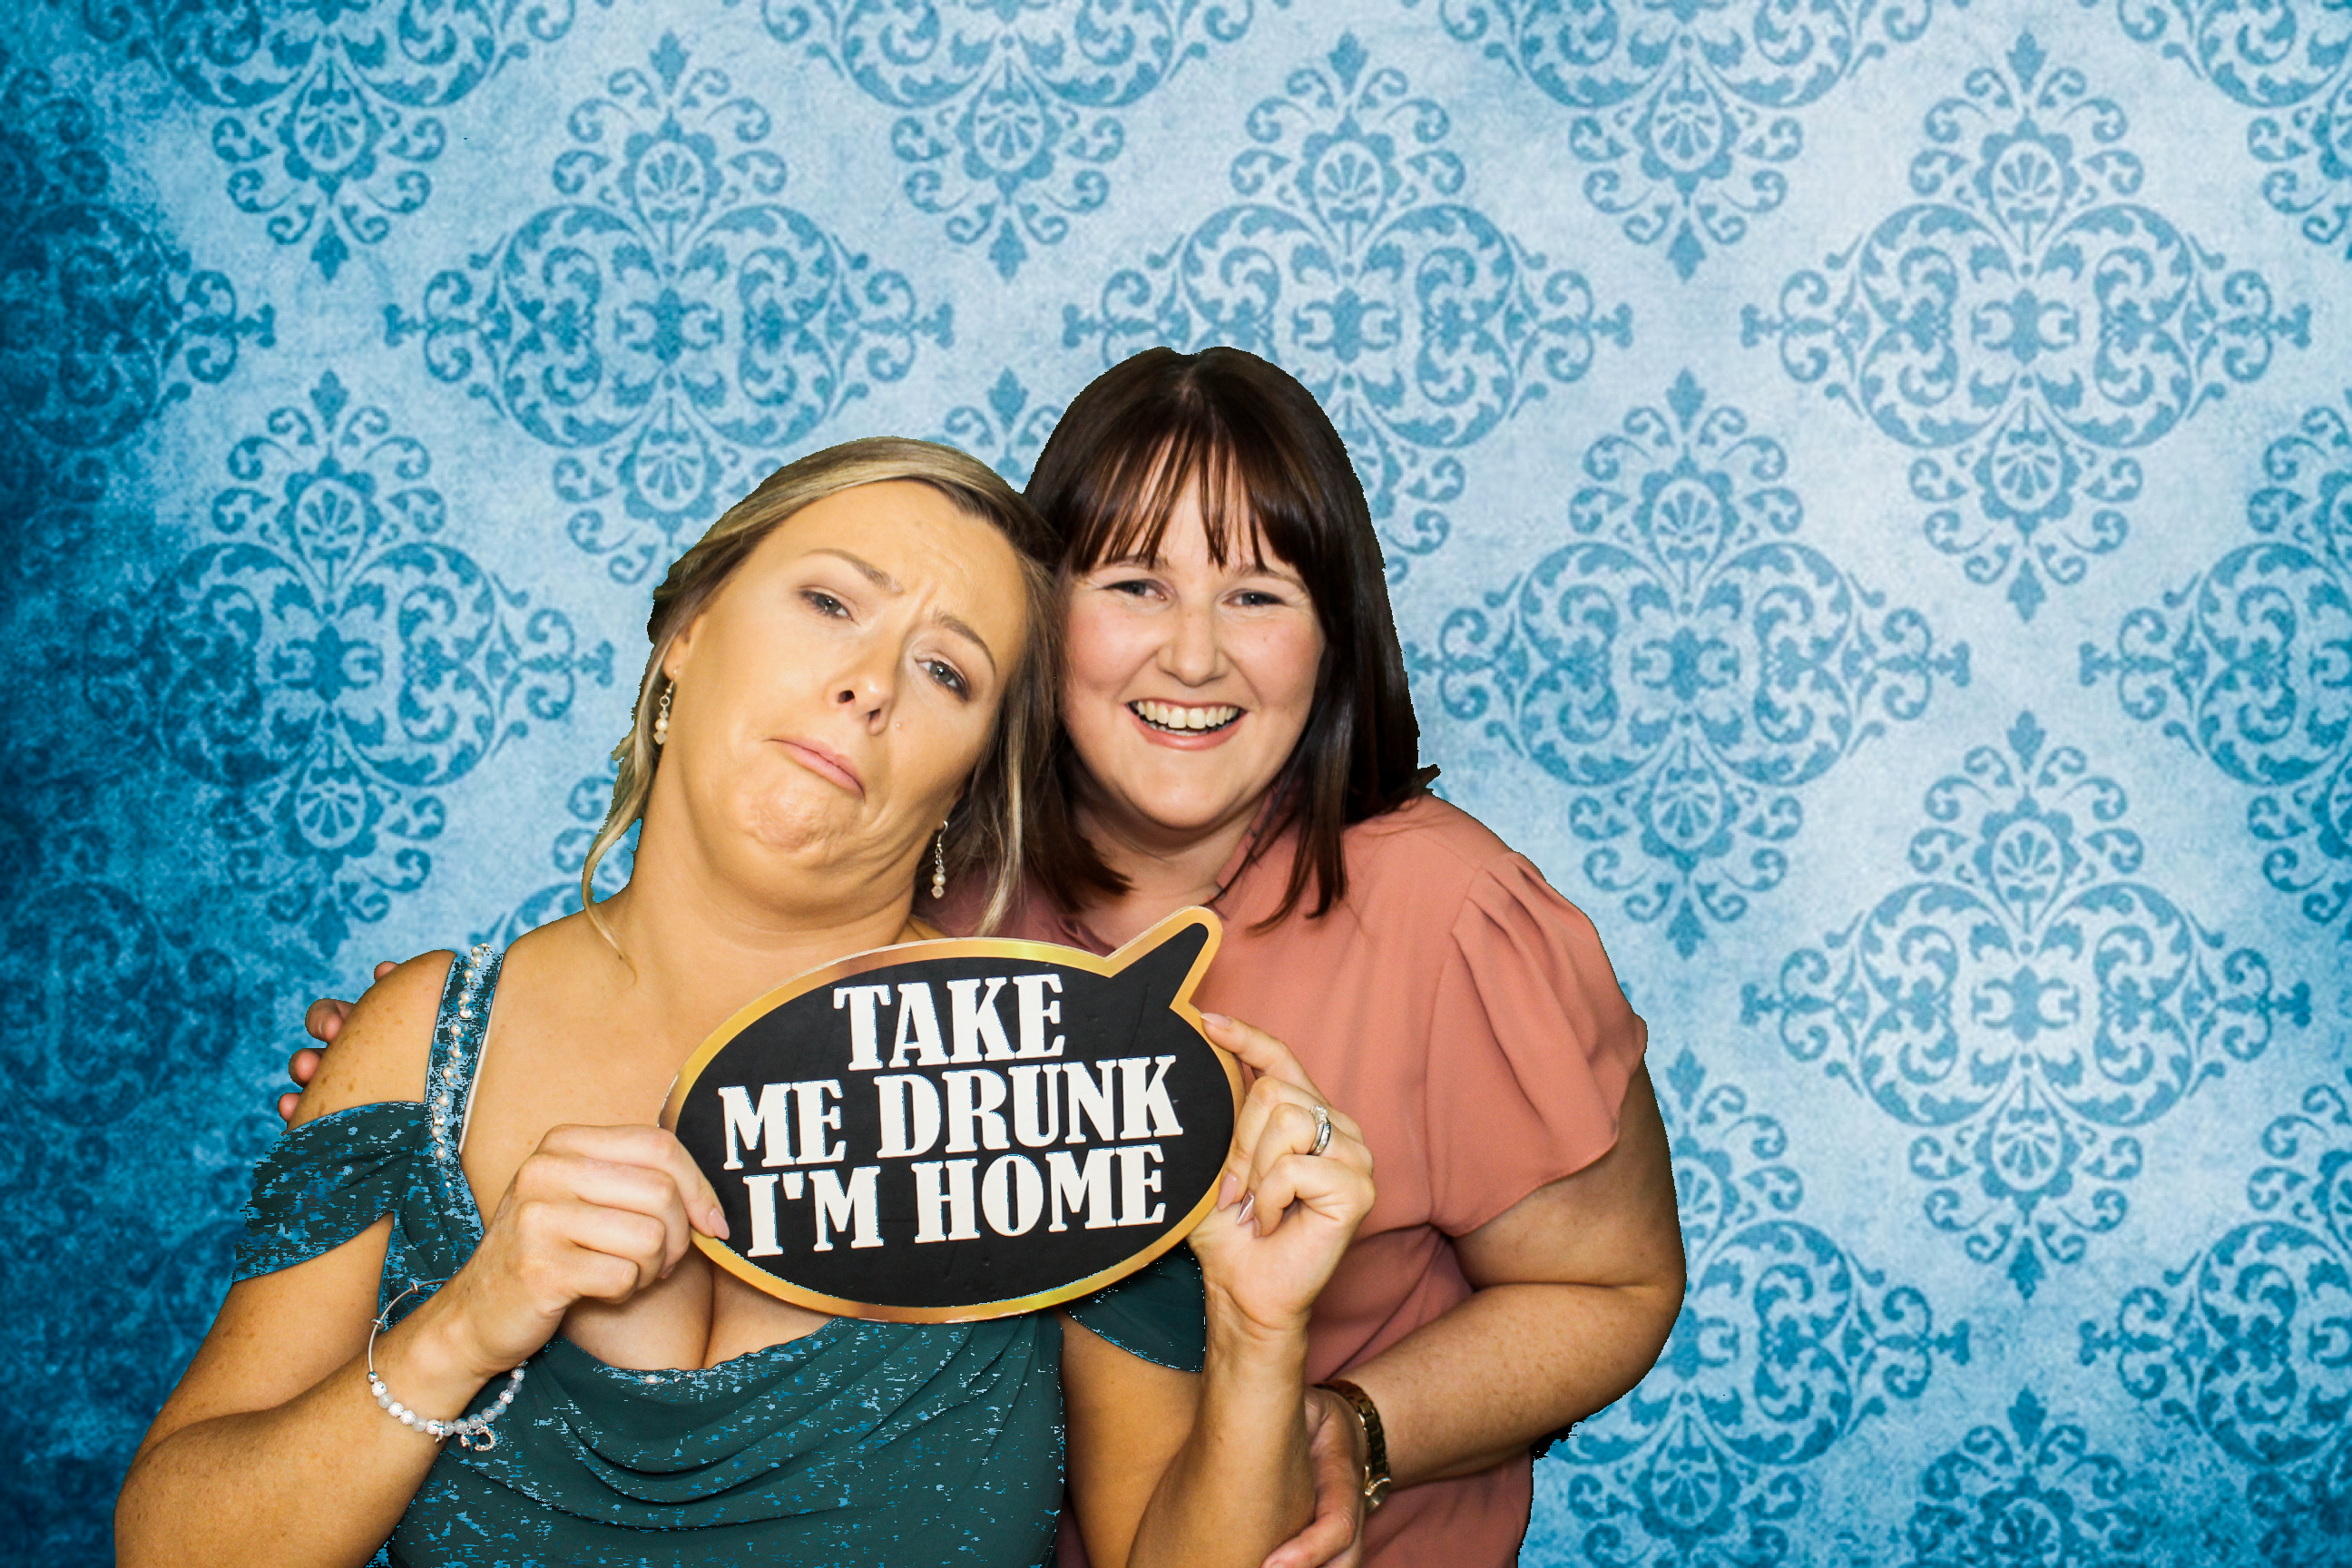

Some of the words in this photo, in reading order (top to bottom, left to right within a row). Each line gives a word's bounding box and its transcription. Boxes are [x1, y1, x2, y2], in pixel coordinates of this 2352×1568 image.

[833, 973, 1066, 1072] TAKE
[718, 1079, 847, 1171] ME
[874, 1054, 1184, 1159] DRUNK
[742, 1165, 885, 1258] I'M
[910, 1143, 1167, 1244] HOME
